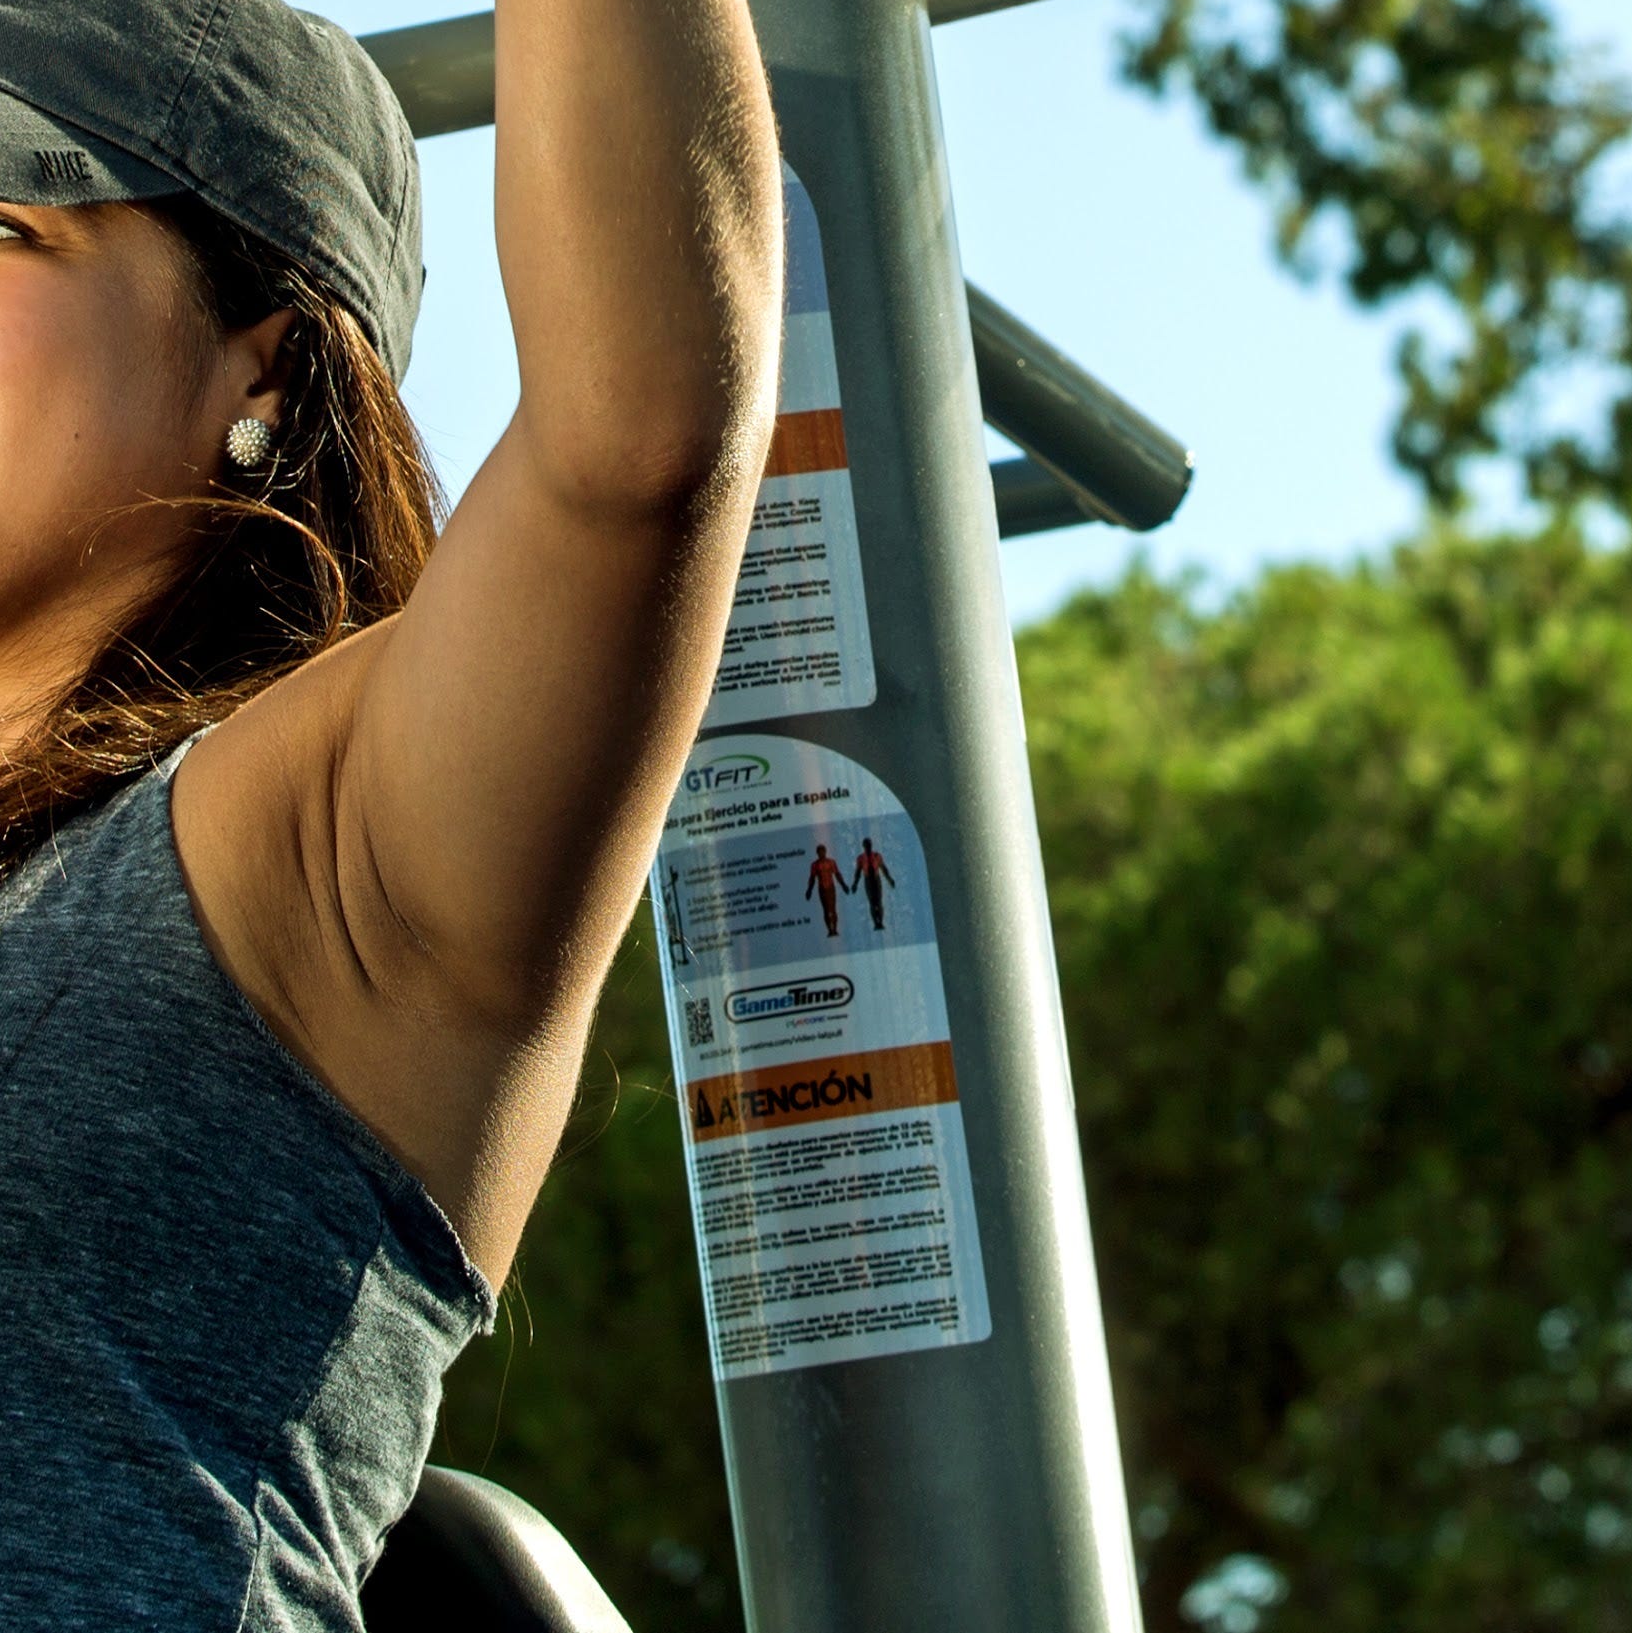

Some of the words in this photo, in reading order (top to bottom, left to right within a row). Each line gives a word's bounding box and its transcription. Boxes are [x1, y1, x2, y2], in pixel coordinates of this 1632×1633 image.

[34, 149, 93, 181] NIKE
[703, 800, 757, 823] Ejercicio
[759, 795, 791, 813] para
[793, 785, 851, 806] Espalda
[736, 817, 749, 828] de
[732, 986, 845, 1016] GameTime
[718, 1069, 874, 1125] ATENCIÓN
